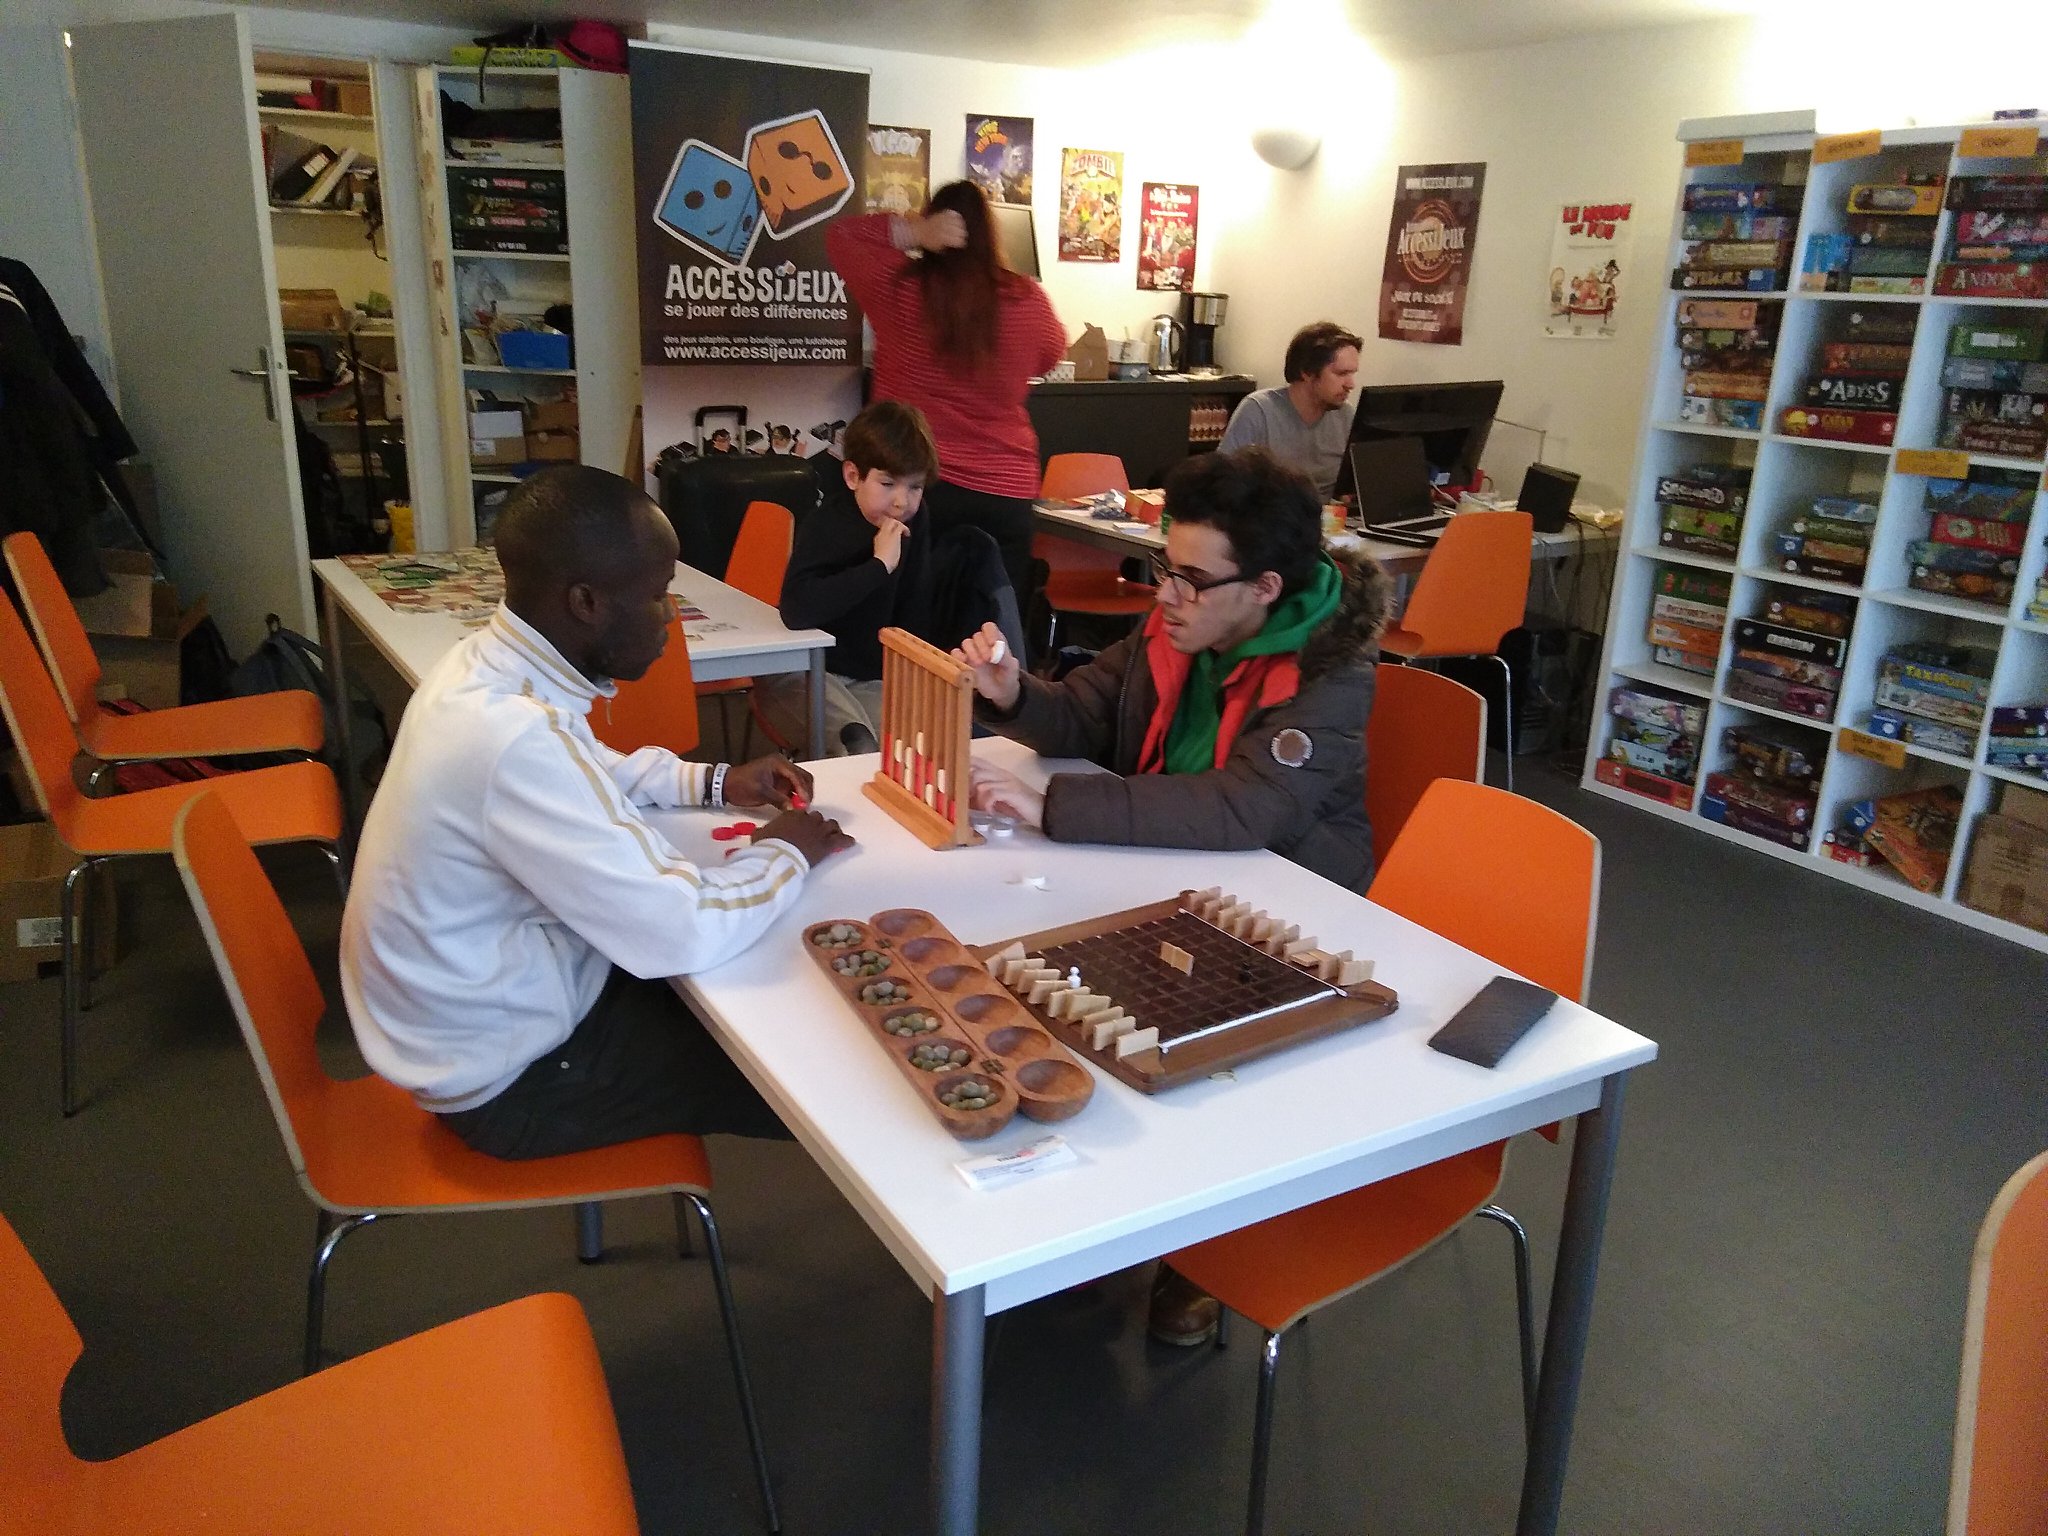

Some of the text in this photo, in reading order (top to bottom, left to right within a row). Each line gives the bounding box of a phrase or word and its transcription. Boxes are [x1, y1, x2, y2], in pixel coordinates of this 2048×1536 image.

[664, 302, 847, 320] se jouer des différences
[664, 345, 847, 362] www.accessijeux.com
[1829, 379, 1890, 402] ABYSS
